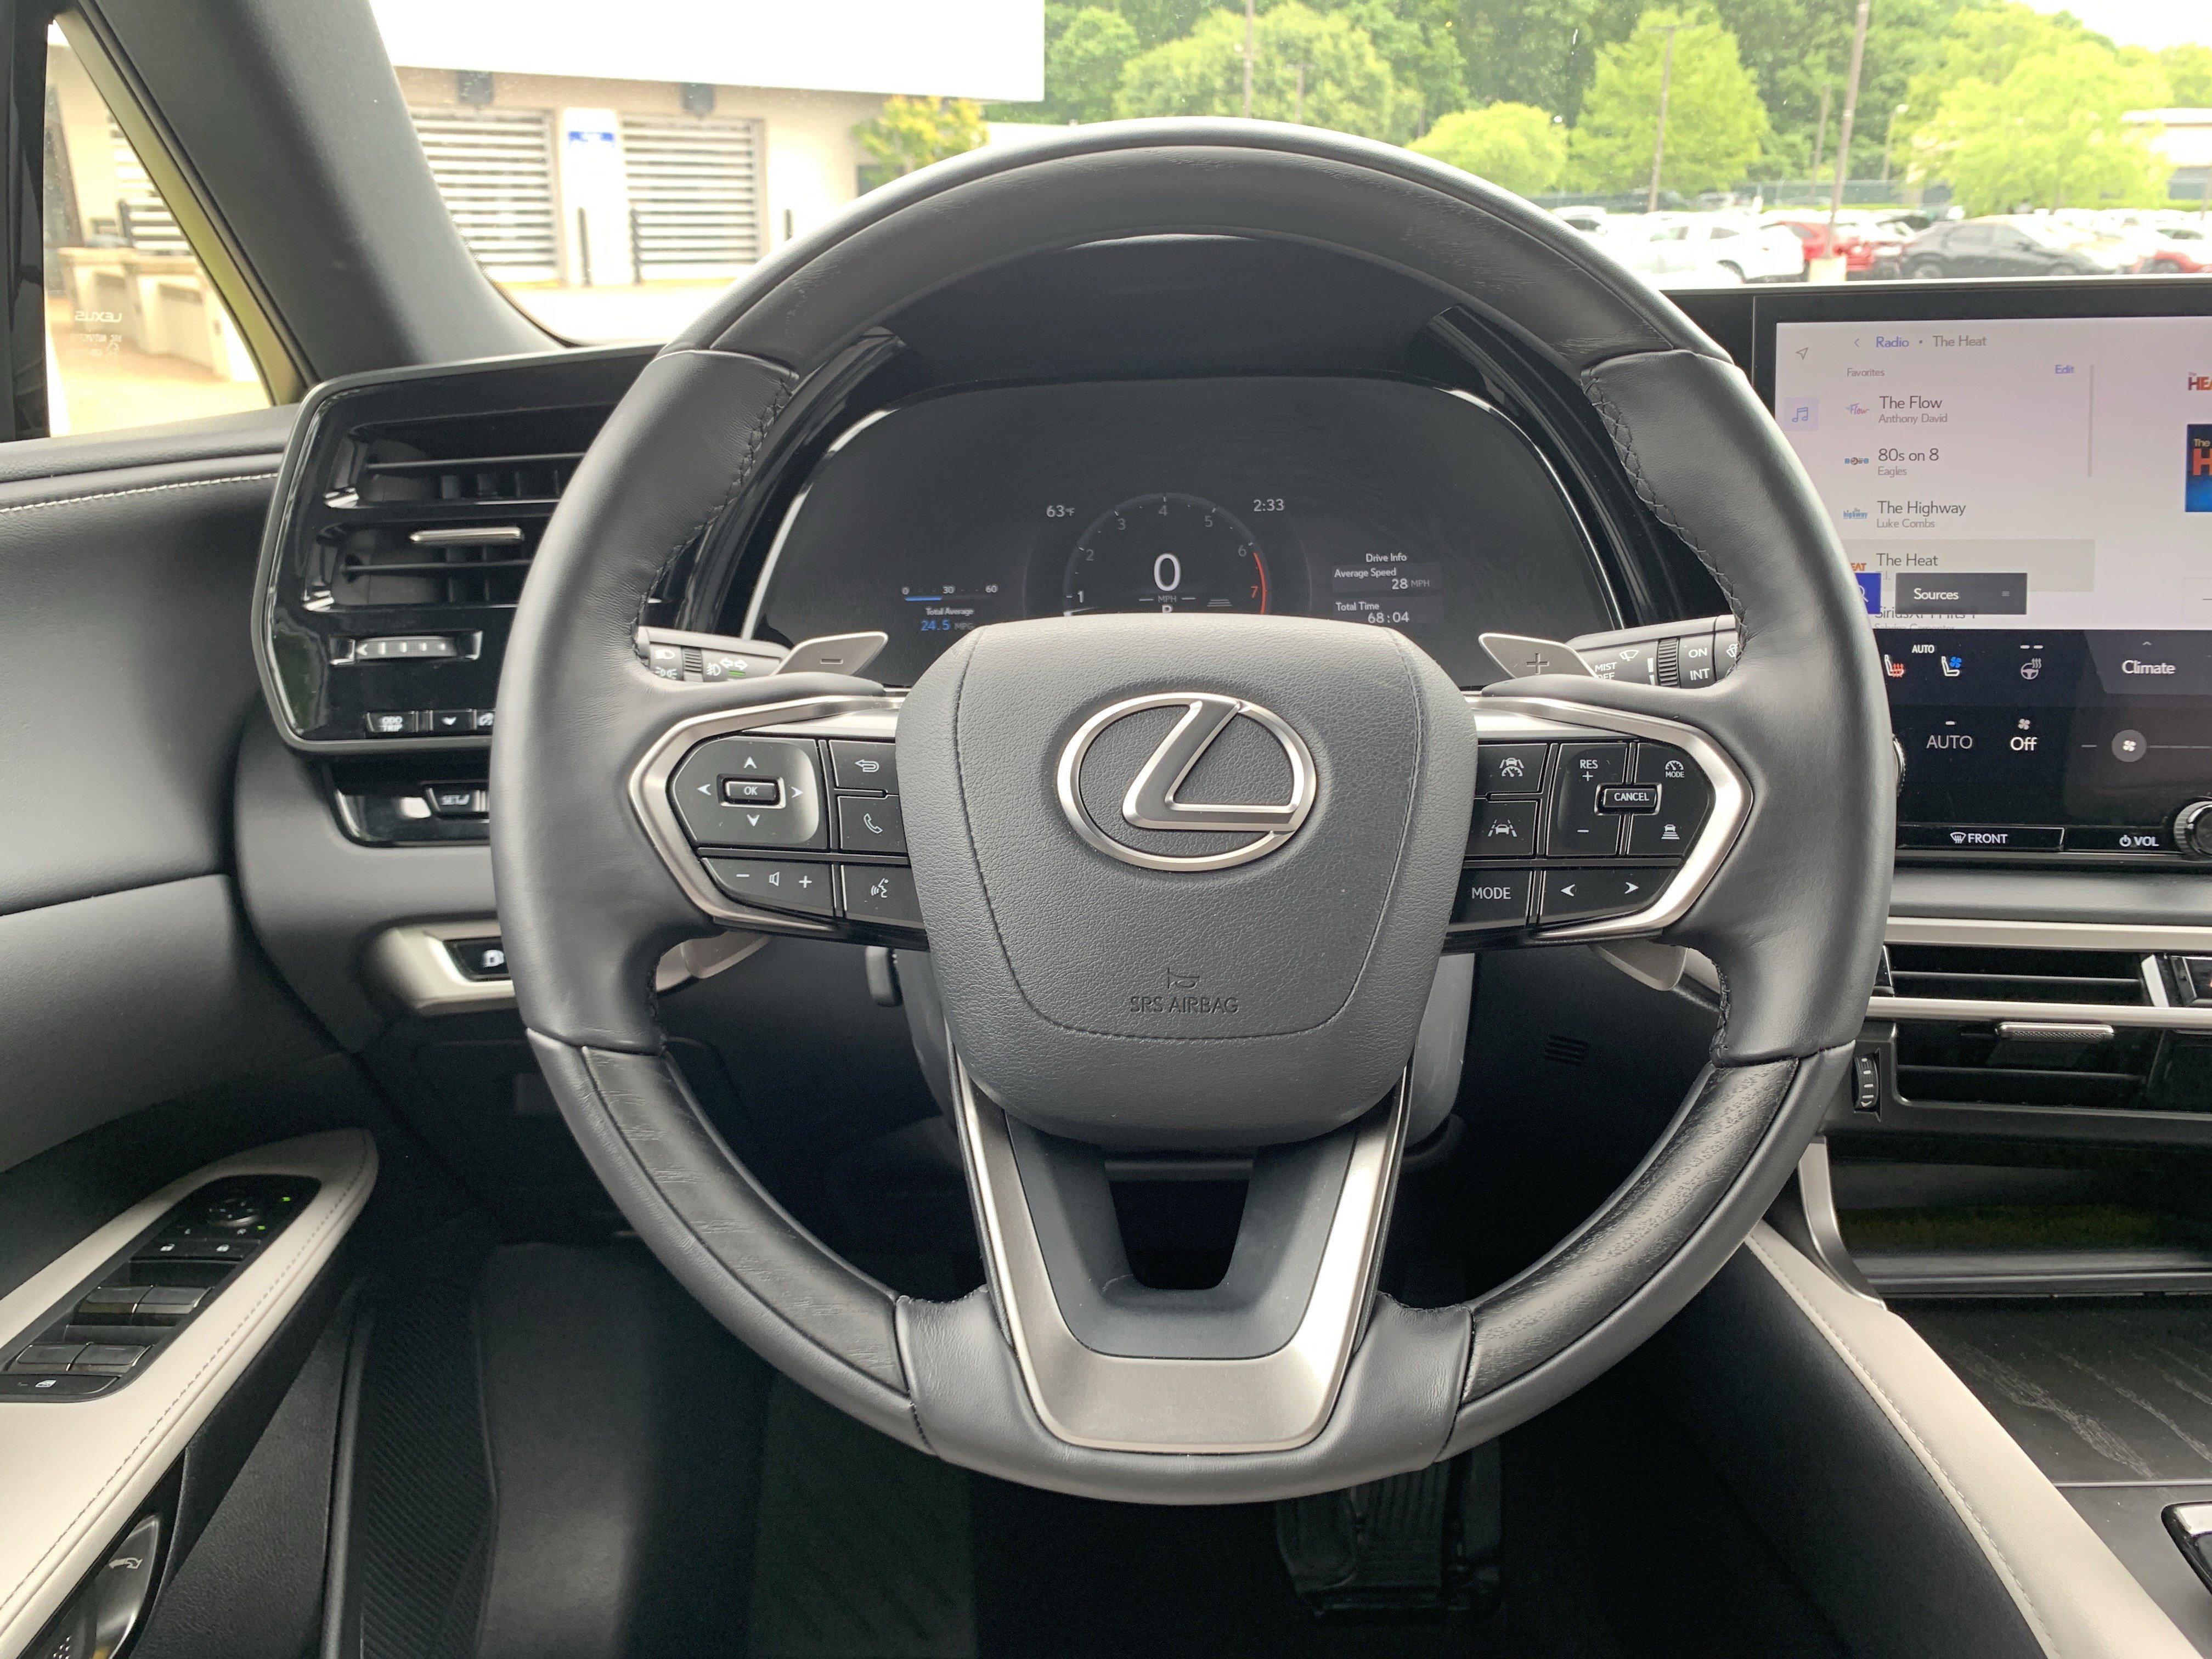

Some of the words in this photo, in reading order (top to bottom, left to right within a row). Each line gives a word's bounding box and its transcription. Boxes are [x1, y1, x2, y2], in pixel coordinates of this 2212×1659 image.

[1876, 336, 1910, 348] Radio
[1932, 335, 1955, 347] The
[1958, 335, 1987, 347] Heat
[1847, 368, 1885, 377] Favorites
[2055, 364, 2075, 374] Edit
[2188, 376, 2212, 391] HE
[1879, 396, 1905, 409] The
[1910, 395, 1943, 409] Flow
[1878, 413, 1918, 425] Anthony
[1921, 413, 1948, 423] David
[1878, 448, 1905, 461] 80s
[1909, 452, 1925, 461] on
[1929, 448, 1939, 461] 8
[1877, 466, 1907, 478] Eagles
[1158, 505, 1167, 516] 4
[1254, 498, 1285, 512] 2:33
[1877, 500, 1903, 514] The
[1907, 500, 1966, 516] Highway
[1116, 518, 1126, 531] 3
[1205, 515, 1213, 528] 5
[1876, 518, 1899, 528] Luke
[1902, 518, 1935, 528] Combs
[1086, 549, 1094, 561] 2
[1238, 545, 1247, 557] 6
[1365, 553, 1389, 562] Drive
[1390, 552, 1407, 562] Info
[1876, 552, 1901, 566] The
[1906, 552, 1938, 566] Heat
[1154, 553, 1181, 591] 0
[1334, 569, 1368, 579] Average
[1370, 567, 1397, 578] Speed
[943, 585, 955, 594] 30
[985, 584, 997, 593] 60
[1392, 578, 1408, 590] 28
[1077, 590, 1084, 603] 1
[1250, 585, 1259, 599] 7
[1914, 588, 1959, 600] Sources
[1158, 595, 1177, 603] MPH
[926, 607, 943, 616] Total
[945, 607, 974, 616] Average
[1335, 601, 1357, 611] Total
[1358, 601, 1380, 610] Time
[1368, 611, 1410, 624] 68:04
[921, 619, 951, 631] 24.5
[954, 622, 974, 630] MPG
[1688, 647, 1708, 658] ON
[1912, 645, 1934, 653] AUTO
[1594, 662, 1617, 673] MIST
[2121, 659, 2175, 675] Climate
[1689, 668, 1710, 681] INT
[1926, 735, 1973, 750] AUTO
[2010, 736, 2038, 752] Off
[1579, 759, 1598, 769] RES
[743, 786, 758, 796] OK
[1613, 792, 1650, 802] CANCEL
[1968, 833, 2008, 844] FRONT
[2134, 836, 2159, 847] VOL
[1471, 887, 1511, 900] MODE
[1130, 996, 1163, 1013] SRS
[1168, 996, 1239, 1014] AIRBAG
